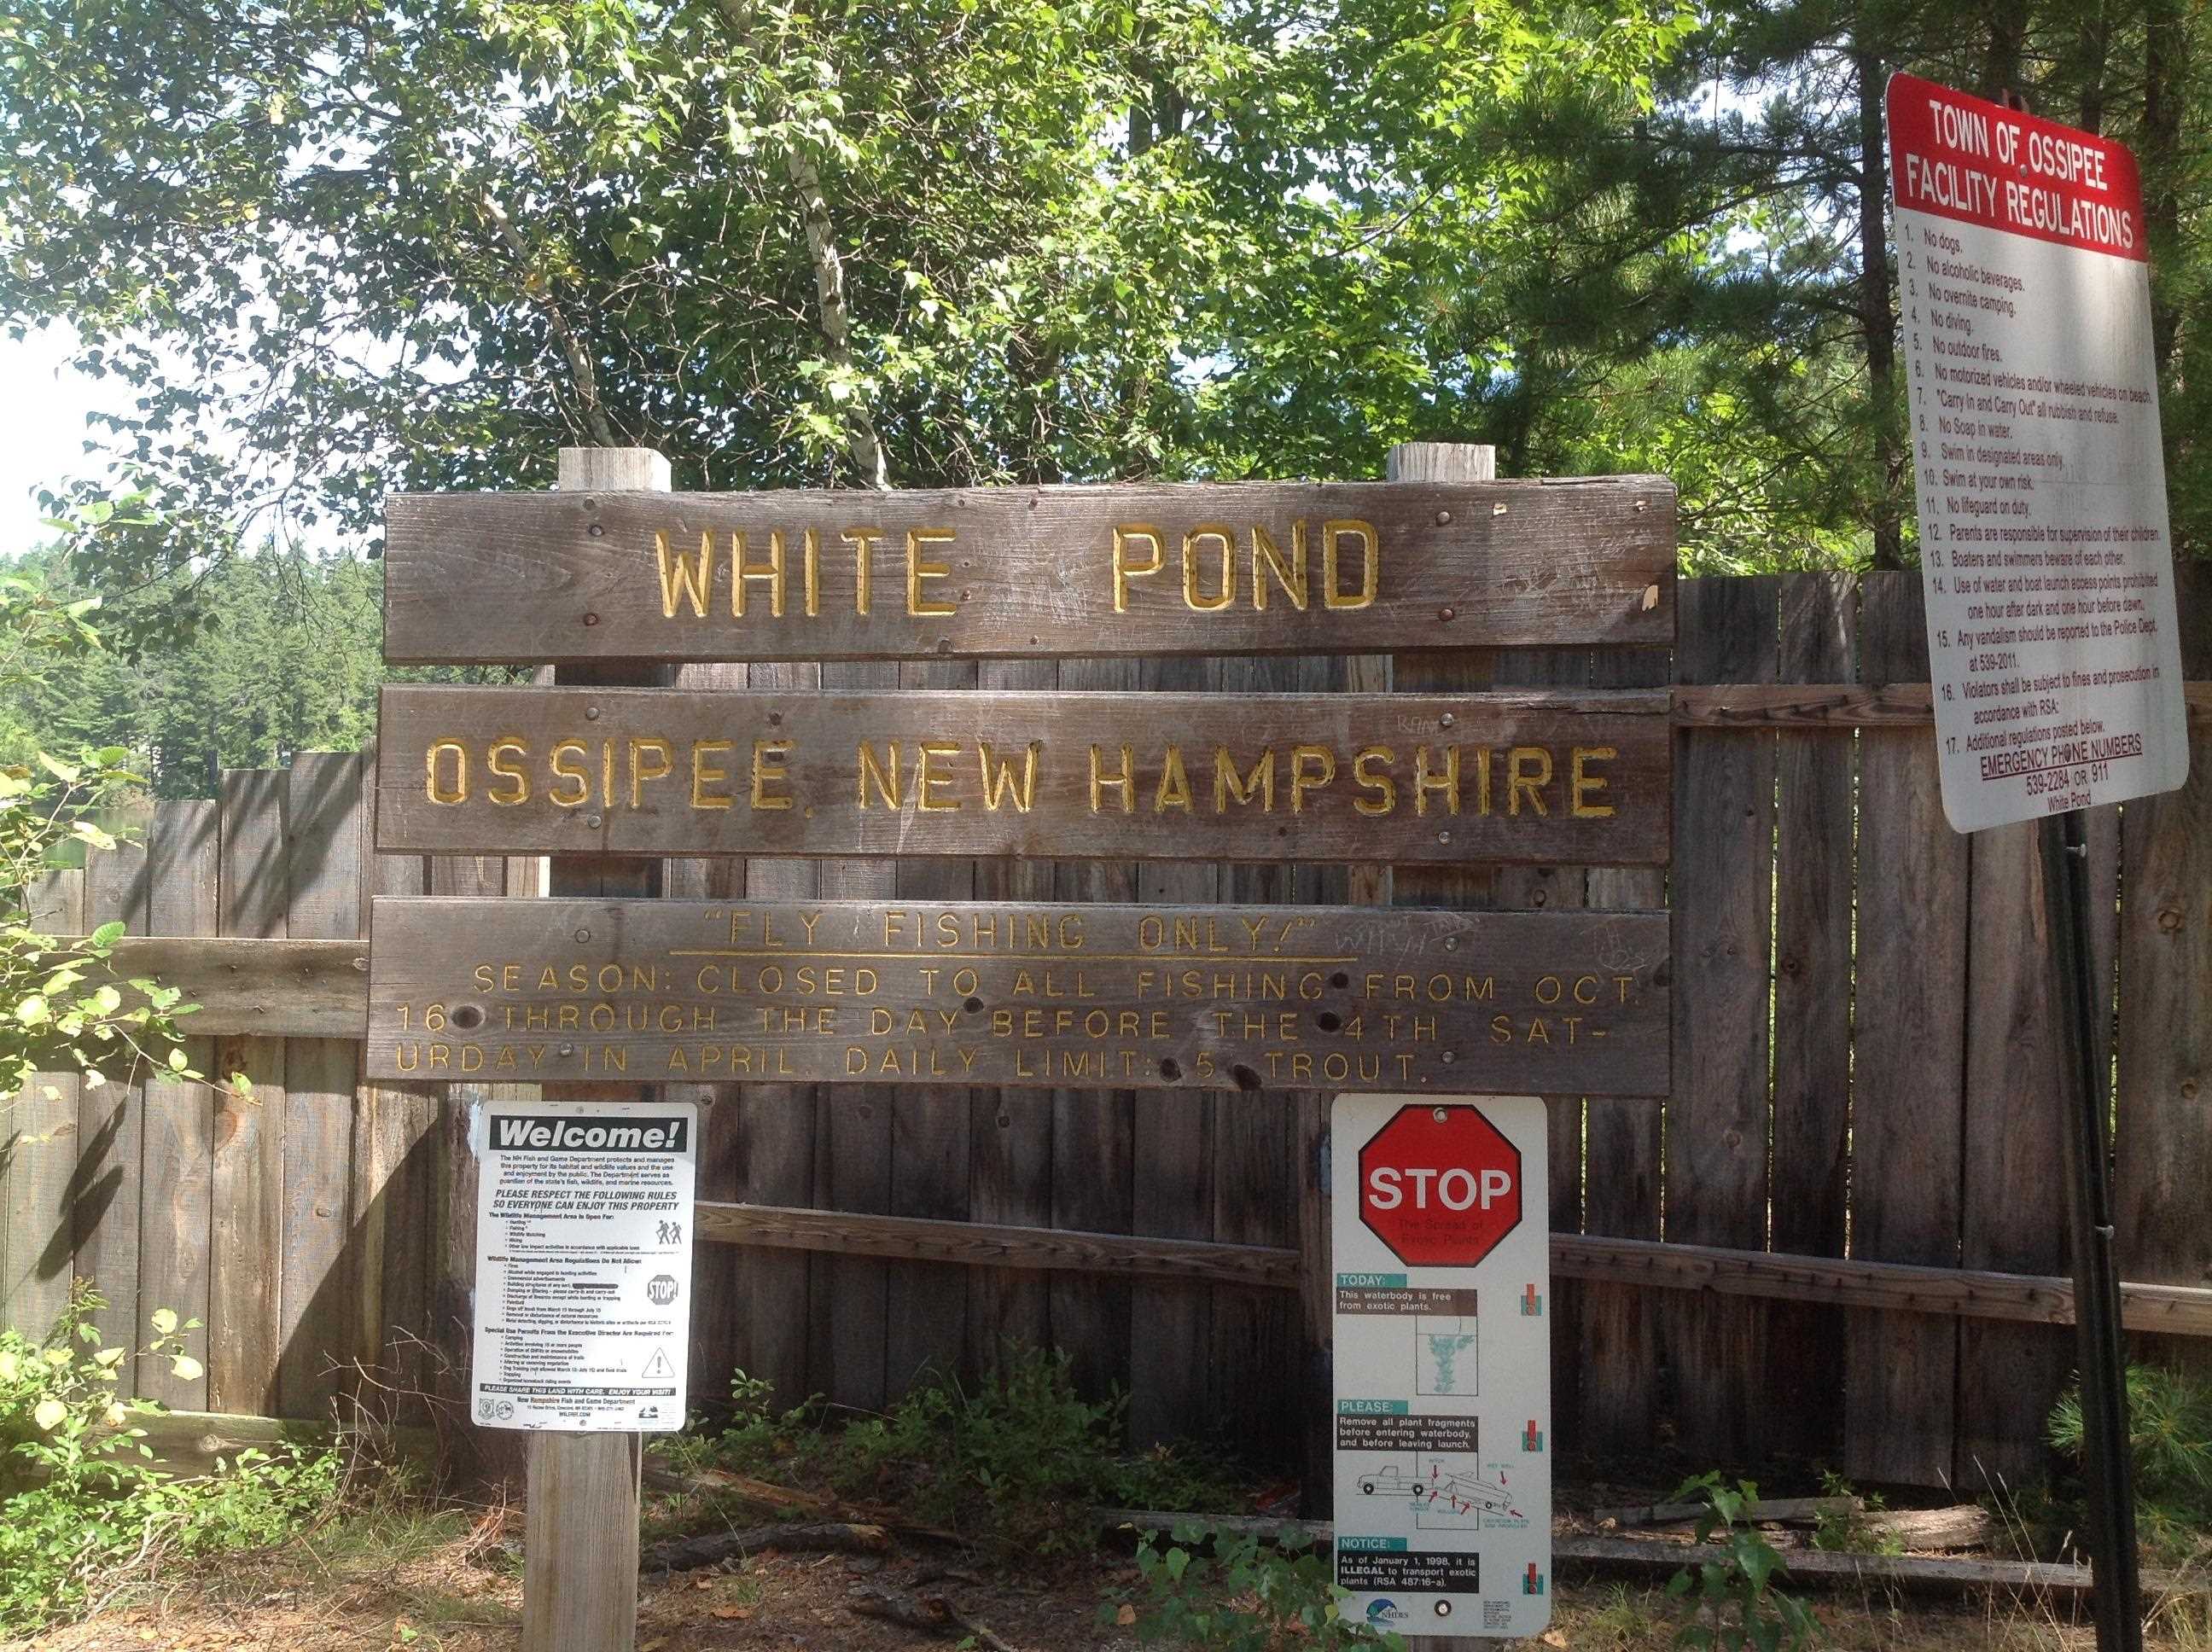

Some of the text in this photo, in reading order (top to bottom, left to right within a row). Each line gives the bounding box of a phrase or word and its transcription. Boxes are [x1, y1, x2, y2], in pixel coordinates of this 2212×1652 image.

[1929, 99, 2108, 190] TOWN OF OSSIPEE
[1906, 154, 2133, 249] FACILITY REGULATIONS
[1905, 223, 1965, 255] 1. No dogs.
[1906, 251, 2025, 294] 2. No alcoholic beverages.
[1908, 278, 2017, 319] 3. No overnite camping.
[1911, 306, 1974, 337] 4. No diving.
[1913, 334, 2003, 363] 5. No outdoor fires.
[1919, 414, 2013, 439] 8. No Soap in water.
[1921, 441, 2065, 470] 9. Swim in designated areas only.
[1924, 468, 1938, 486] 10.
[1942, 468, 1966, 487] Swim
[1968, 472, 1977, 488] at
[1978, 474, 1997, 492] your
[1999, 476, 2015, 491] own
[1947, 497, 1959, 513] No
[1962, 497, 1998, 518] lifeguard
[2000, 501, 2010, 515] on
[655, 518, 1379, 618] WHITE POND
[1970, 654, 1979, 672] at
[1946, 718, 2105, 754] 17. Additional regulations posted below.
[1980, 732, 2143, 777] EMERGENCY PHONE NUMBERS
[858, 739, 1042, 812] NEW
[1089, 742, 1617, 817] HAMPSHIRE
[2026, 761, 2110, 797] 539-2284 OR 911
[2047, 791, 2092, 813] White Pond
[883, 910, 1086, 950] FISHING
[474, 963, 672, 993] SEASON:
[697, 964, 878, 996] CLOSED
[919, 968, 979, 997] TO
[1014, 969, 1096, 998] ALL
[1138, 971, 1324, 1000] FISHING
[1365, 974, 1495, 1001] FROM
[397, 1004, 445, 1032] 16
[500, 1003, 716, 1032] THROUGH
[757, 1007, 836, 1035] THE
[871, 1009, 959, 1036] DAY
[992, 1009, 1171, 1038] BEFORE
[1212, 1012, 1298, 1040] THE
[1491, 1015, 1606, 1044] SAT-
[396, 1044, 545, 1072] URDAY
[584, 1044, 627, 1072] IN
[847, 1047, 977, 1076] DAILY
[1195, 1050, 1215, 1079] 5
[1265, 1052, 1428, 1083] TROUT.
[499, 1120, 680, 1149] Welcome!
[496, 1190, 678, 1200] PLEASE RESPECT THE FOLLOWING RULES
[1368, 1166, 1511, 1211] STOP
[493, 1200, 680, 1211] SO EVERYONE CAN ENJOY THIS PROPERTY
[1342, 1275, 1385, 1285] TODAY:
[1340, 1290, 1359, 1299] This
[1365, 1291, 1413, 1301] waterbody
[1432, 1292, 1452, 1300] free
[1340, 1301, 1432, 1312] from exotic plants.
[1340, 1417, 1377, 1426] Remove
[1399, 1418, 1423, 1428] plant
[1428, 1419, 1476, 1428] fragments
[1340, 1428, 1371, 1436] before
[1376, 1428, 1415, 1439] entering
[1340, 1438, 1357, 1446] and
[1363, 1438, 1394, 1447] before
[1399, 1439, 1432, 1449] leaving
[1342, 1539, 1391, 1549] NOTICE:
[1341, 1556, 1353, 1564] As
[1358, 1556, 1367, 1564] of
[1372, 1556, 1408, 1567] January
[1456, 1557, 1463, 1566] it
[1468, 1557, 1476, 1566] is
[1341, 1566, 1476, 1578] ILLEGAL to transport exotic
[1341, 1577, 1368, 1586] plants
[1373, 1577, 1396, 1586] (RSA
